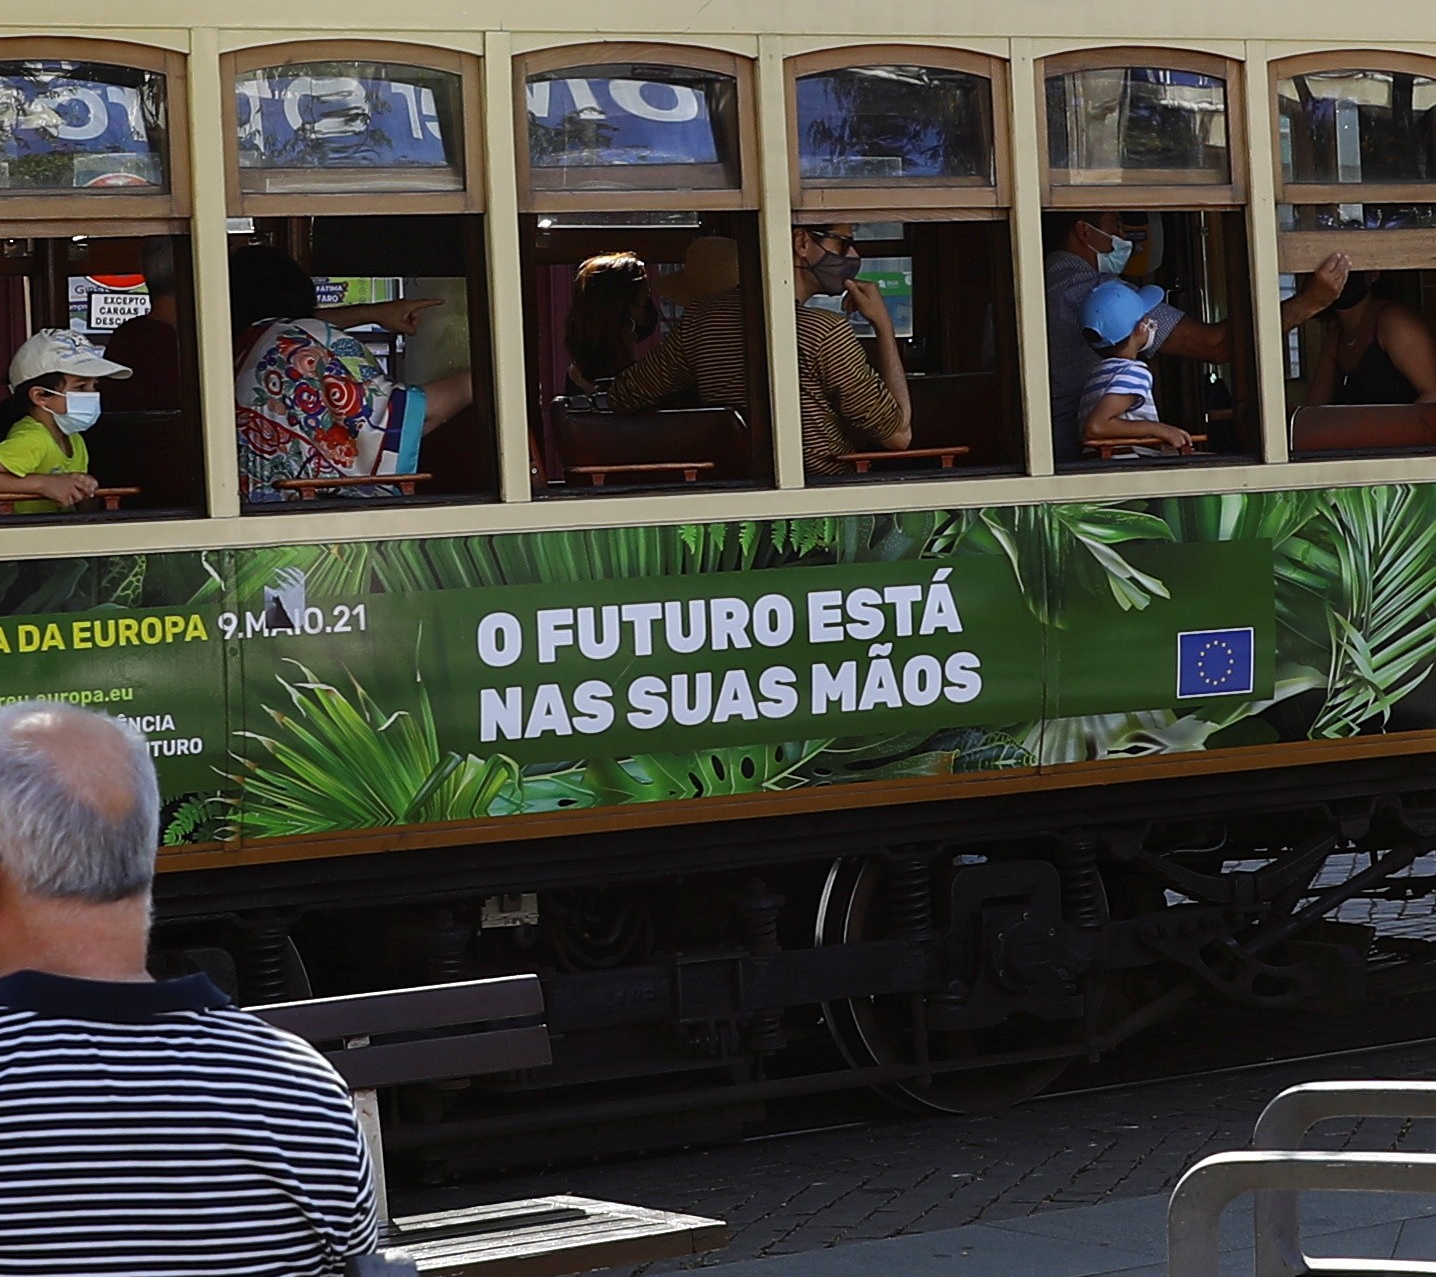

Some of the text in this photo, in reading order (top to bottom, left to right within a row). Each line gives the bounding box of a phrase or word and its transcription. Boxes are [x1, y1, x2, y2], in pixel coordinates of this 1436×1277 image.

[99, 306, 140, 316] CARGAS
[103, 296, 147, 306] EXCEPTO
[17, 623, 66, 653] DA
[72, 614, 209, 650] EUROPA
[476, 567, 963, 668] O FUTURO ESTÁ
[479, 642, 983, 742] NAS SUAS MÃOS
